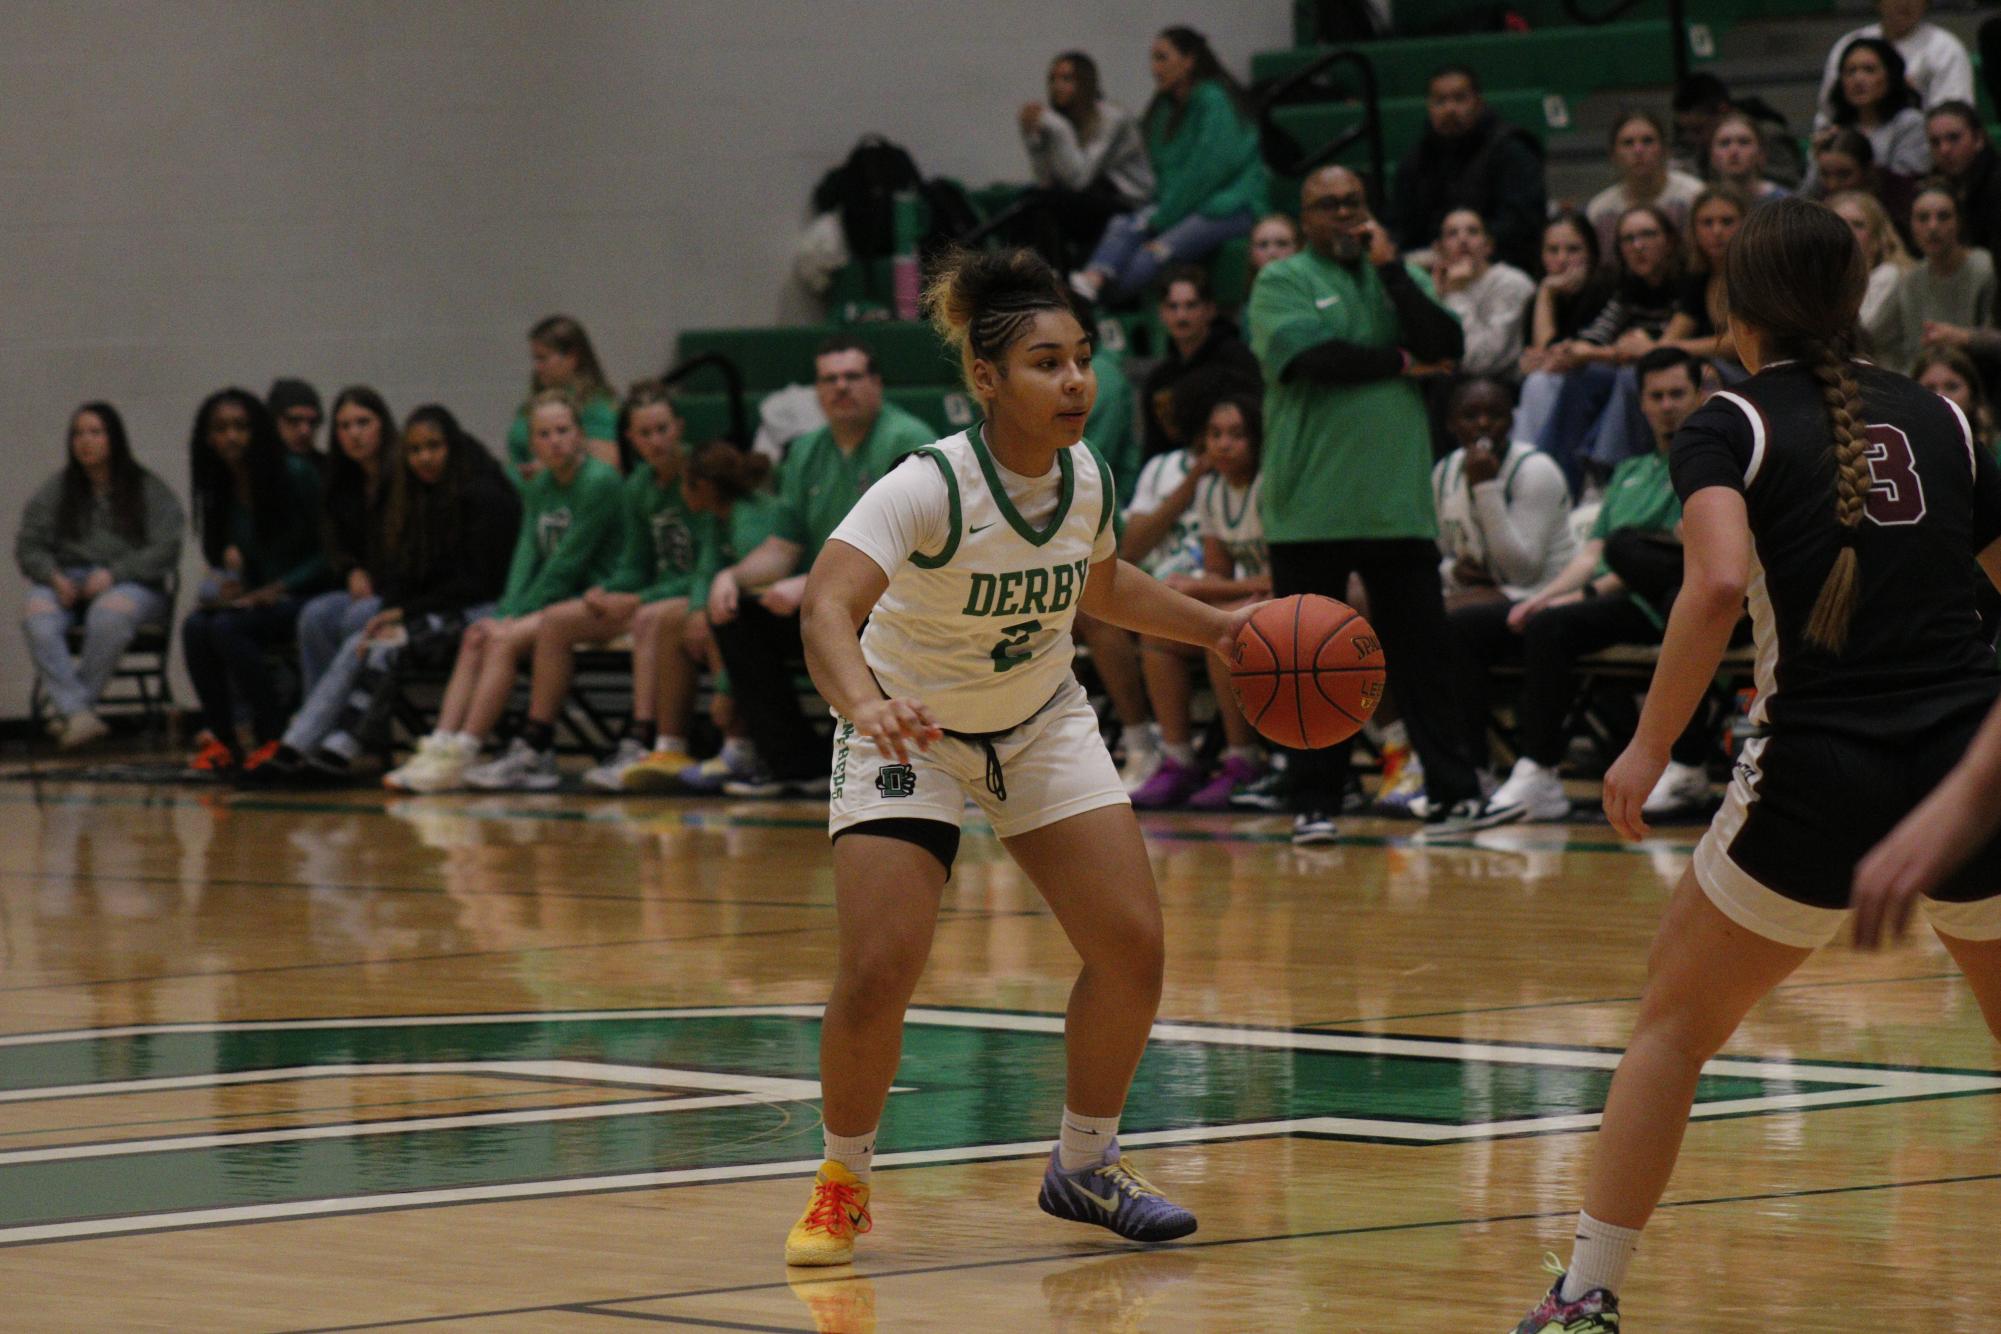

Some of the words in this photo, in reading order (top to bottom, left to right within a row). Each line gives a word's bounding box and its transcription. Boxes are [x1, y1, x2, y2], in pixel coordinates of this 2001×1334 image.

[1863, 423, 1927, 526] 3
[962, 558, 1088, 616] DERBY
[991, 619, 1043, 673] 2
